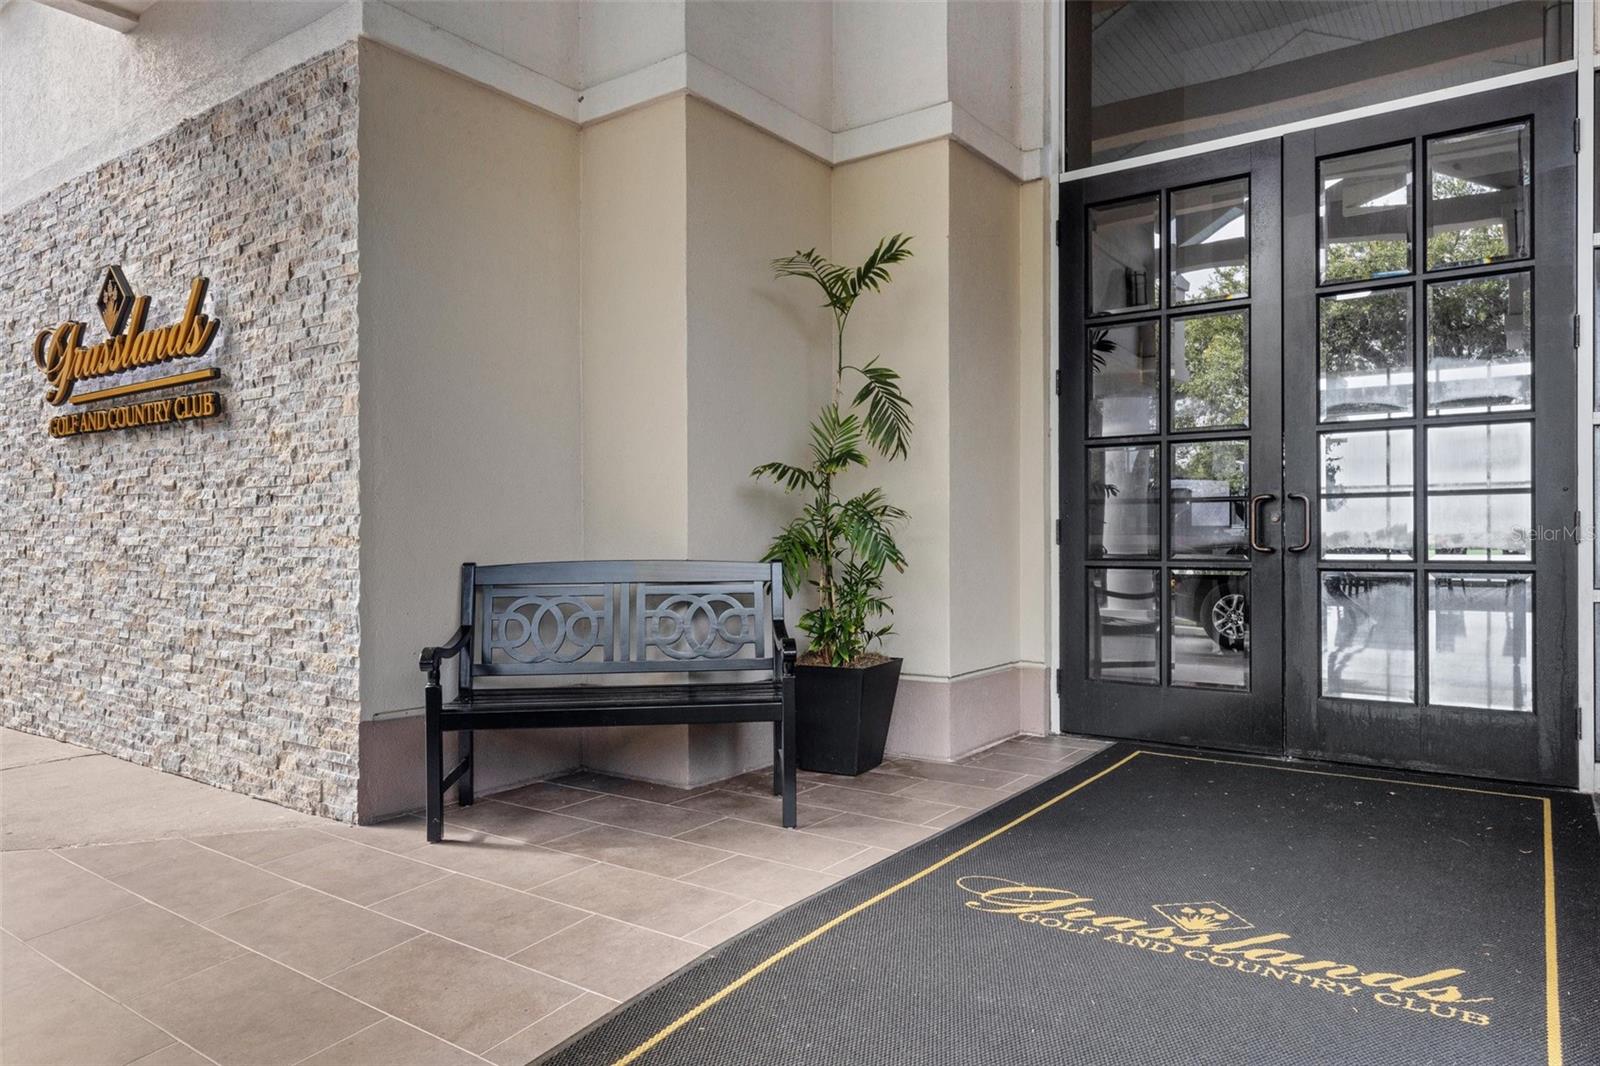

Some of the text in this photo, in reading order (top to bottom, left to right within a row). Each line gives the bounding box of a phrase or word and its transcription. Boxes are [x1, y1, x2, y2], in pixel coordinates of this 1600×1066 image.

[33, 276, 220, 407] Grasslands
[50, 393, 215, 438] GOLF AND COUNTRY CLUB
[957, 875, 1494, 1003] Grasslands
[1018, 912, 1491, 1026] GOLF AND COUNTRY CLUB
